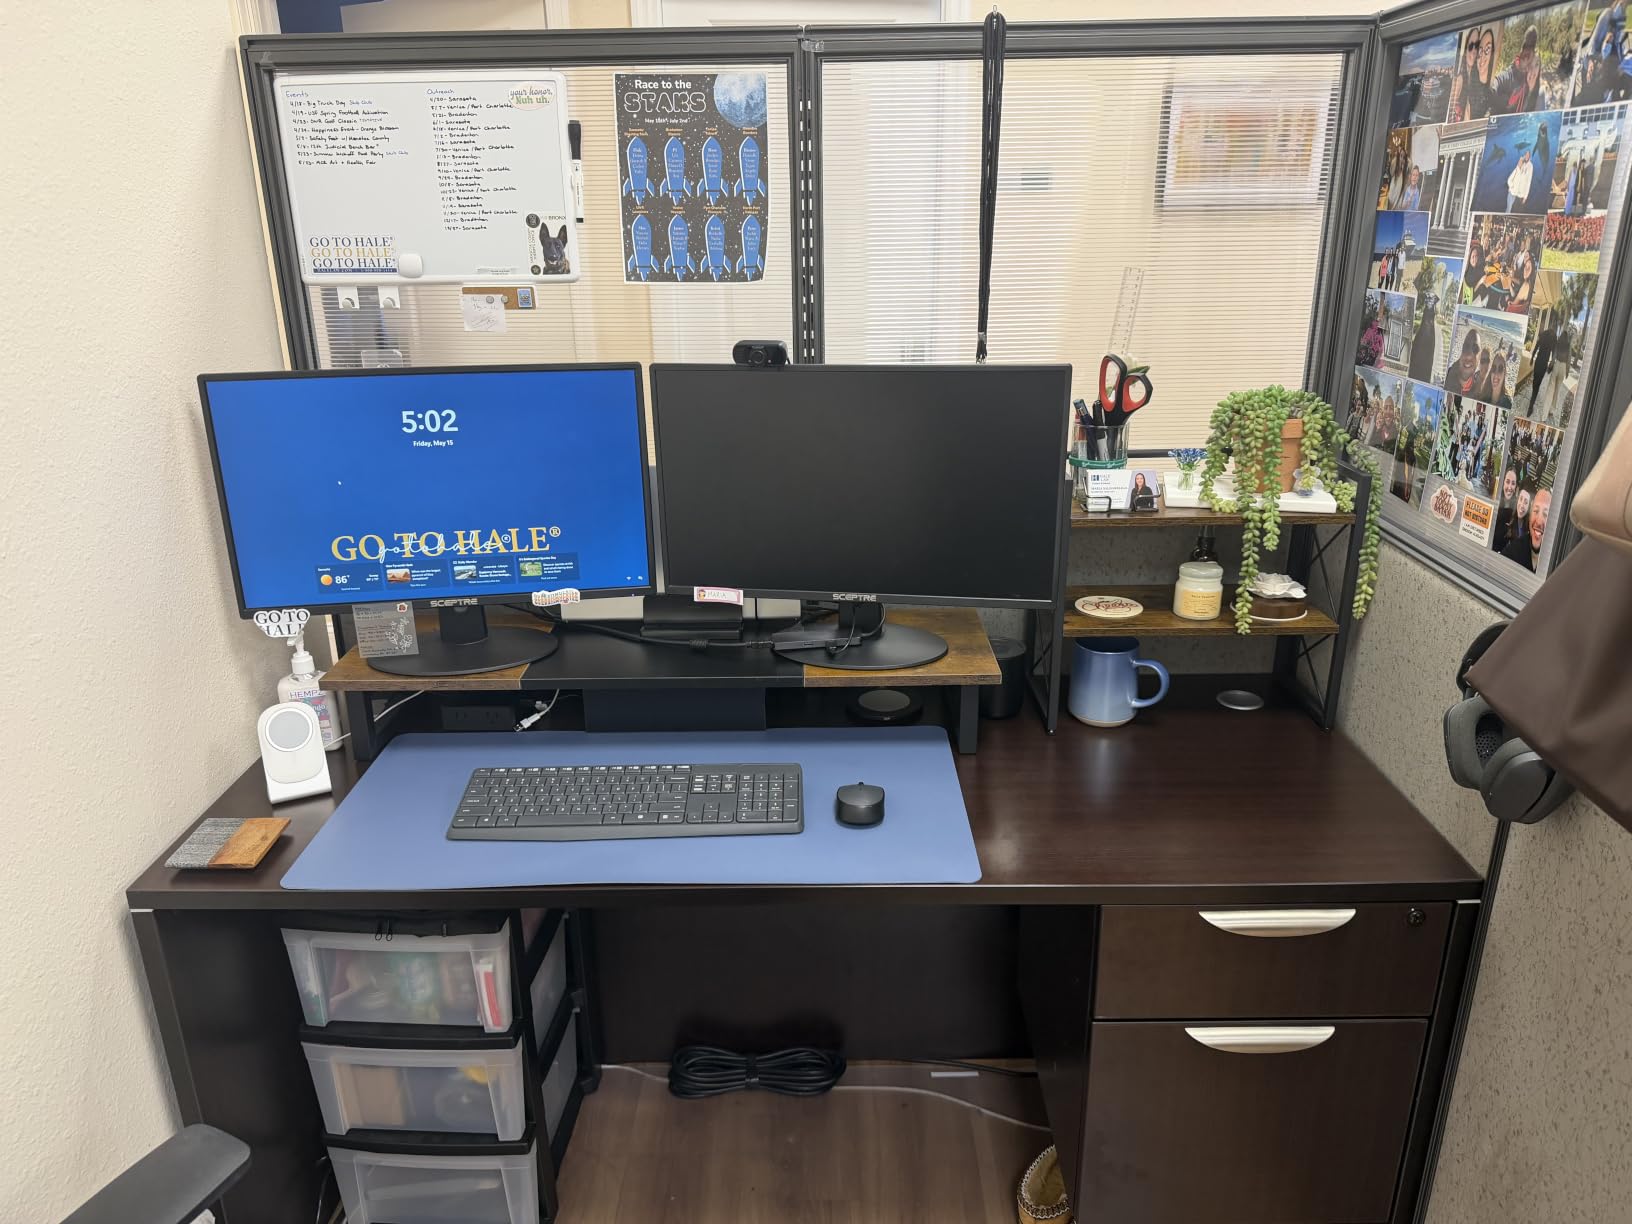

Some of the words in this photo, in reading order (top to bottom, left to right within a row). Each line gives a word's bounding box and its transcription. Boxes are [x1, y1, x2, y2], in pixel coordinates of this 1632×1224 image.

[634, 80, 659, 90] Race
[662, 80, 672, 90] to
[675, 80, 691, 90] the
[510, 90, 527, 100] your
[516, 96, 533, 104] Nuh
[536, 96, 550, 104] uh.
[624, 91, 707, 113] STARS
[372, 134, 390, 142] County
[310, 237, 330, 248] GO
[332, 237, 352, 248] TO
[311, 248, 331, 258] GO
[334, 248, 352, 258] TO
[312, 258, 332, 268] GO
[334, 258, 354, 268] TO
[402, 409, 458, 434] 5:02
[433, 440, 446, 448] May
[1466, 500, 1482, 513] PLEASE
[331, 534, 384, 562] GO
[394, 530, 446, 559] TO
[832, 593, 877, 602] SCEPTRE
[430, 598, 478, 608] SCEPTRE
[256, 612, 280, 624] GO
[284, 610, 308, 622] TO
